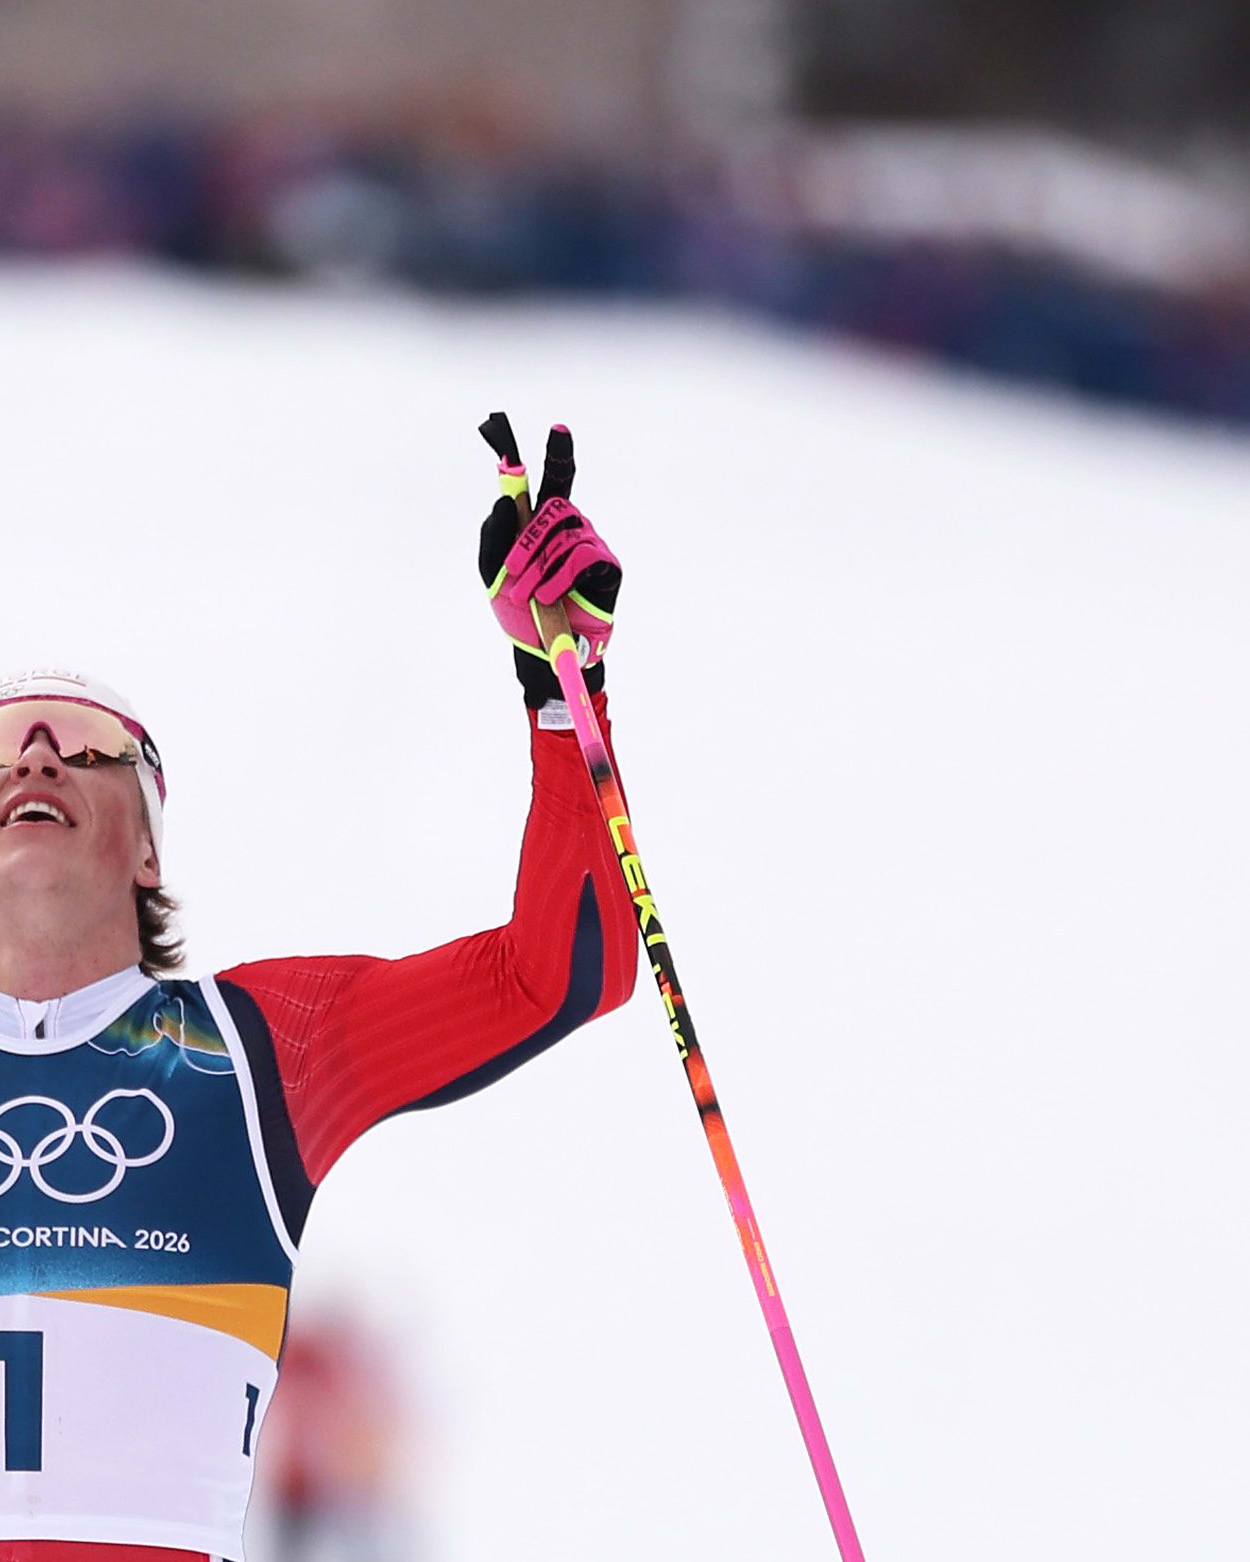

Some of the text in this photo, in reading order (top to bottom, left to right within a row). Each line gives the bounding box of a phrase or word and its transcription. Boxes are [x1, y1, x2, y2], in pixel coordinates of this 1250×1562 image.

[518, 499, 568, 551] HESTR
[608, 815, 667, 948] LEKI
[134, 1229, 191, 1253] 2026
[242, 1382, 261, 1457] 1
